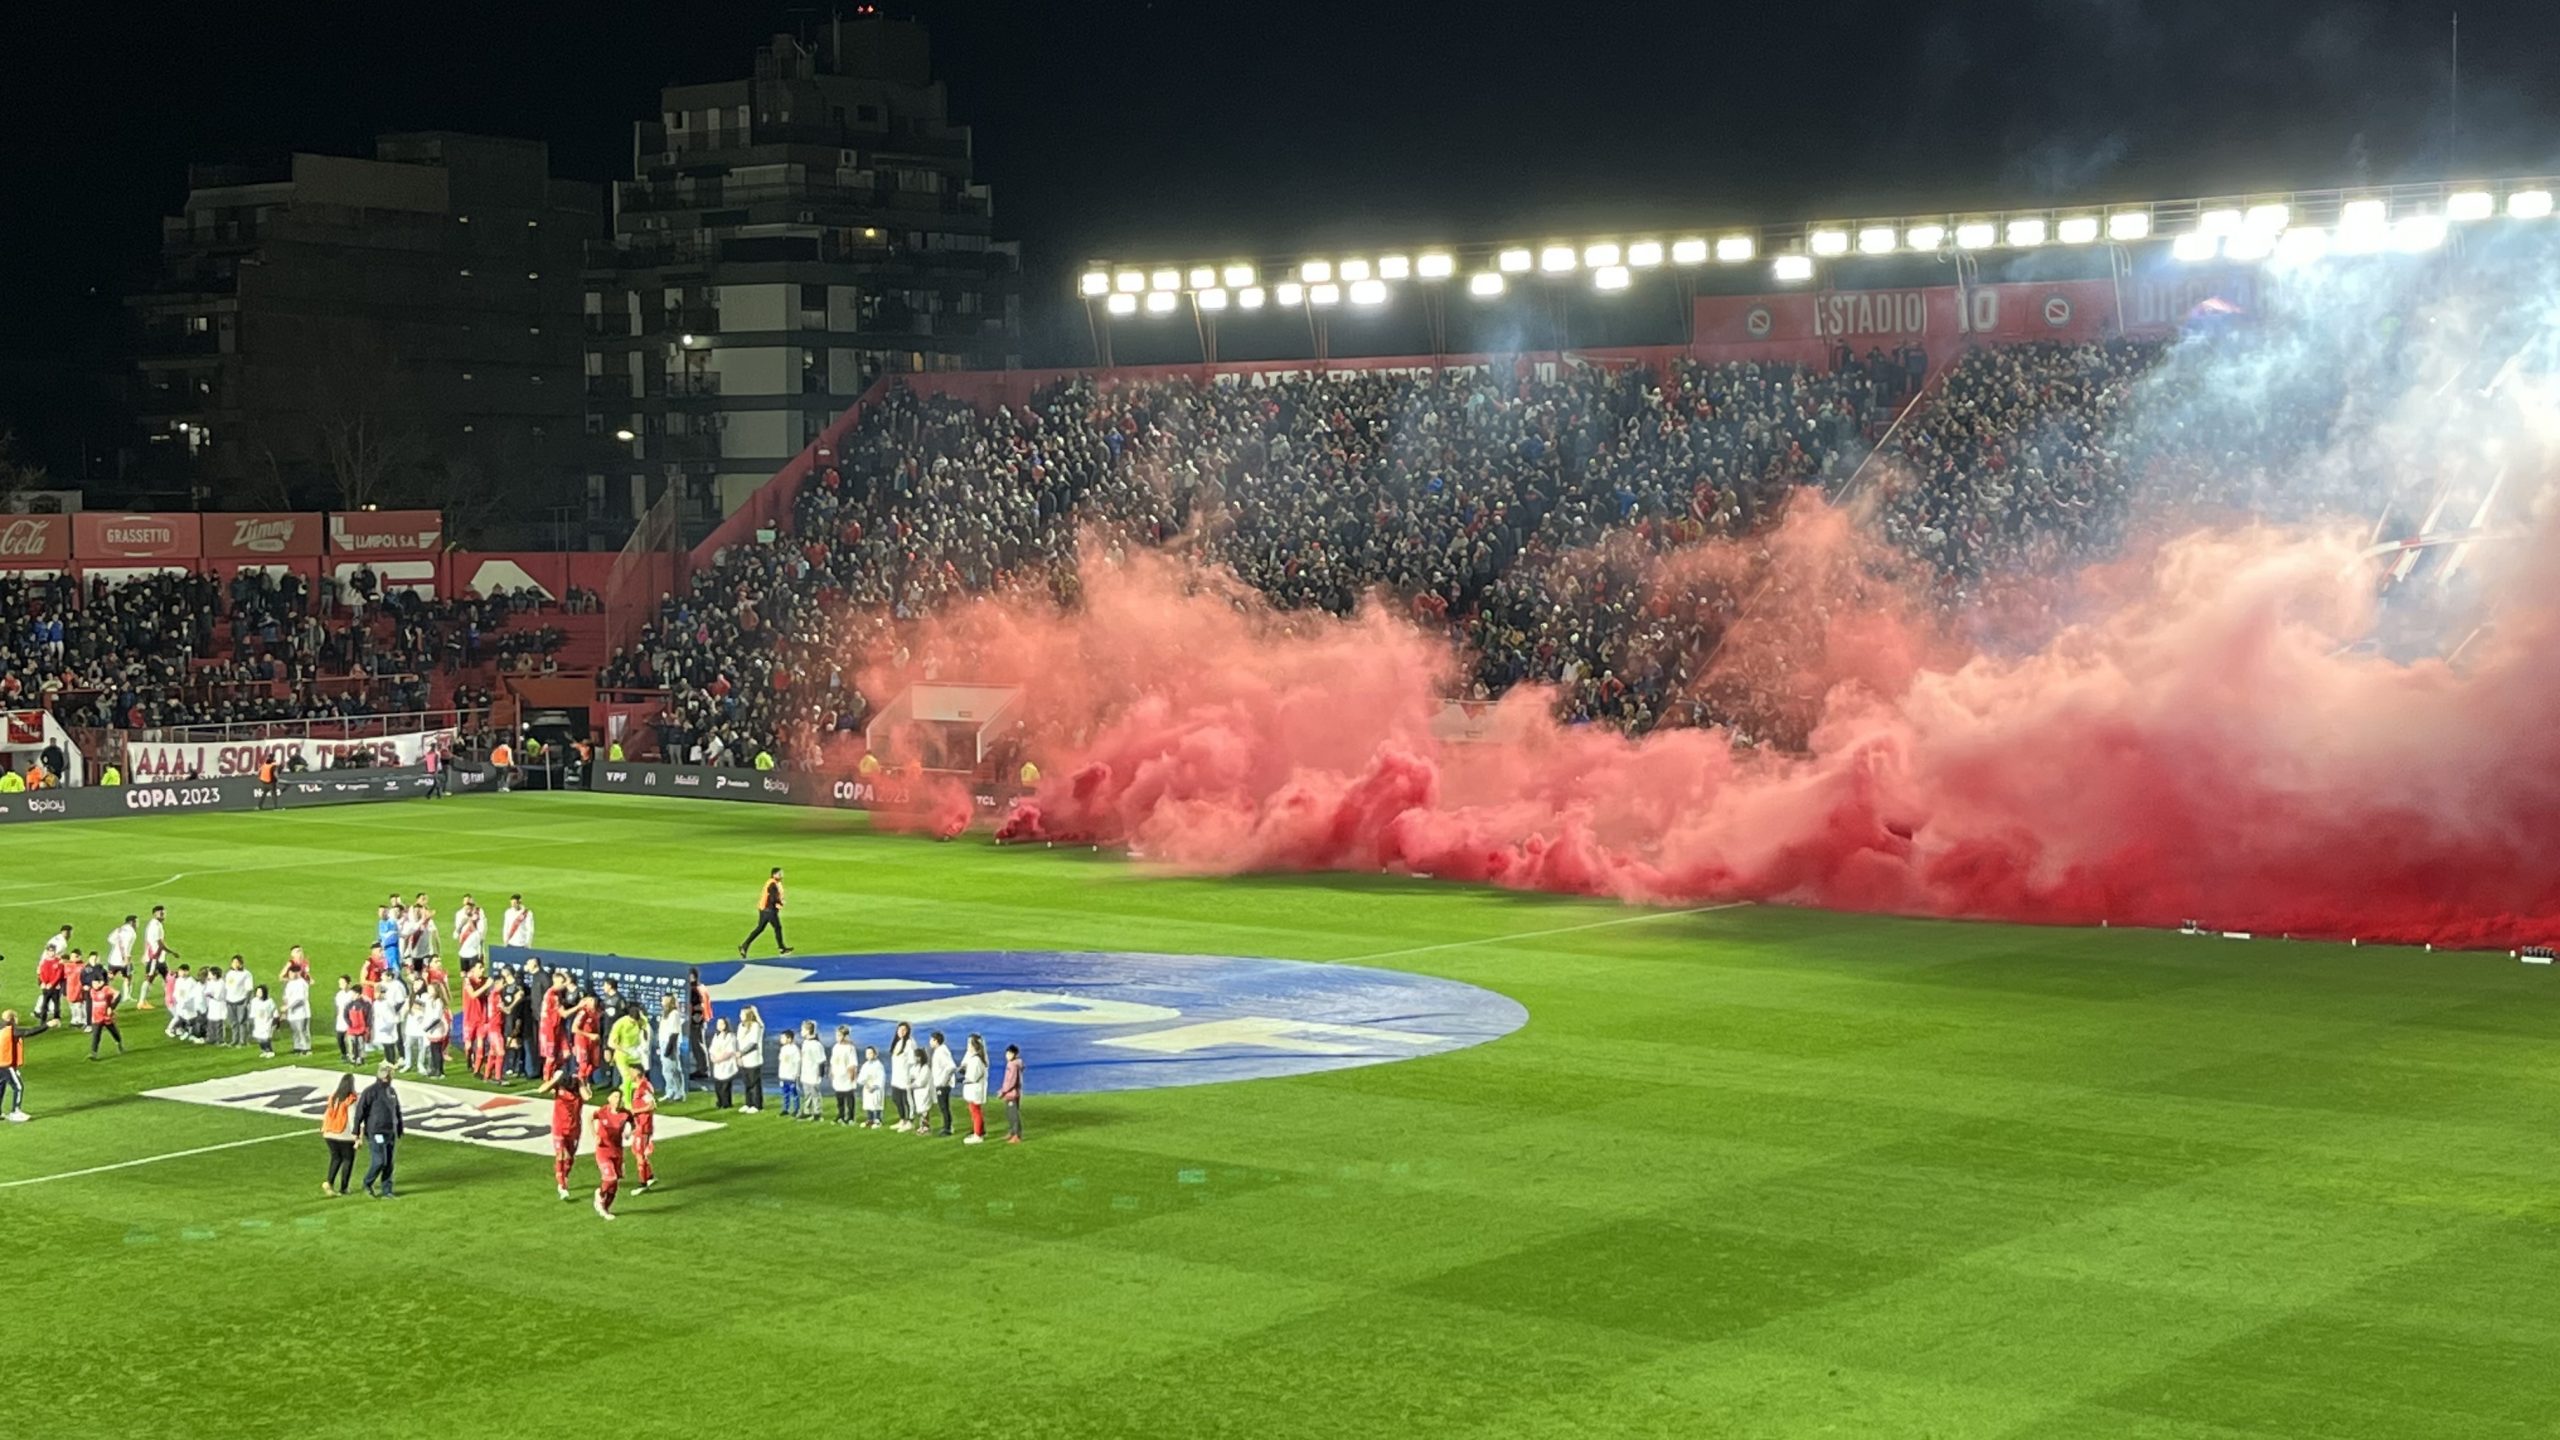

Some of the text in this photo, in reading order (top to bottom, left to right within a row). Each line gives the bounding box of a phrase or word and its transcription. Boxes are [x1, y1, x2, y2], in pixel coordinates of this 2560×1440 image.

[1814, 292, 1922, 336] ESTADIO
[1957, 289, 1998, 334] 10
[1213, 369, 1314, 390] PLATEA
[106, 528, 171, 544] GRASSETTO
[136, 747, 205, 775] AAAJ
[316, 740, 396, 770] TDOS
[606, 771, 627, 782] YPF
[126, 786, 221, 809] COPA 2023
[833, 780, 875, 802] COPA
[976, 795, 996, 806] TCL
[218, 1085, 553, 1141] Nldo
